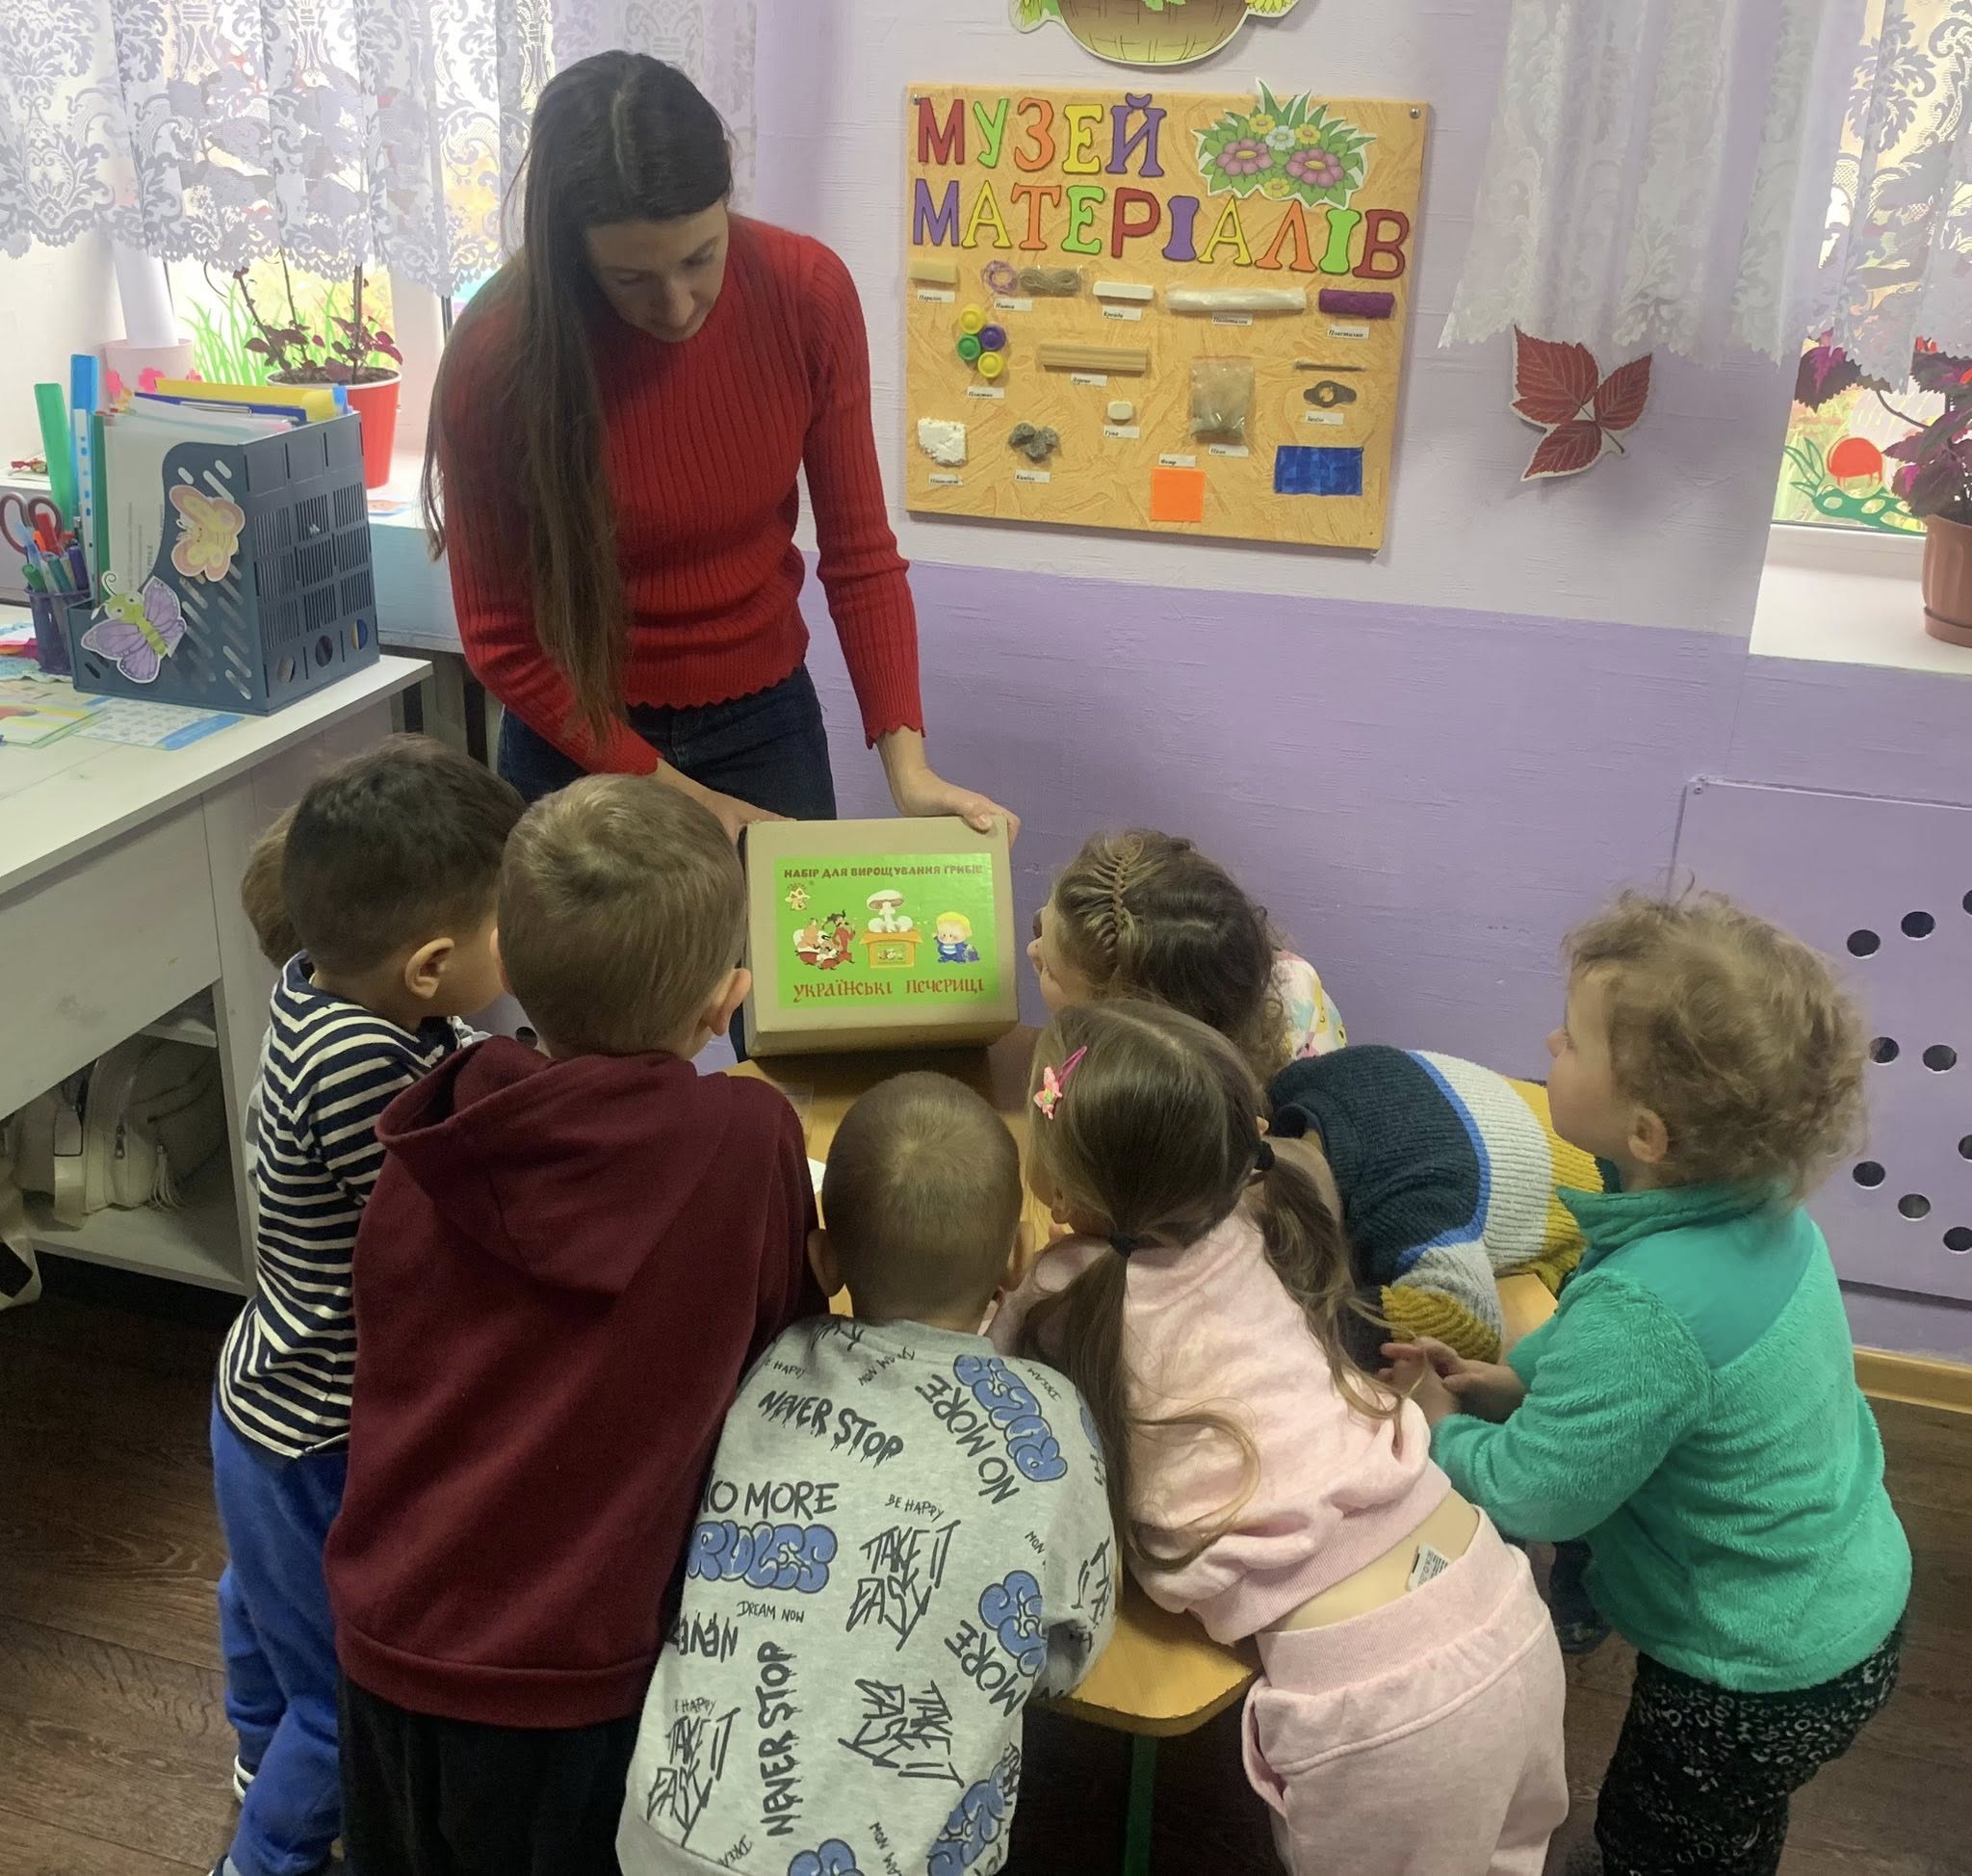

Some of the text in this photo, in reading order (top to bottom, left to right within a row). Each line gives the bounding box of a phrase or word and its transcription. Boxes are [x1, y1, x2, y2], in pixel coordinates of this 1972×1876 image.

[918, 91, 1167, 177] МУЗЕЙ
[913, 177, 1410, 279] МАТЕРІАЛІВ
[784, 868, 819, 878] НАБІР
[821, 868, 848, 878] ДЛЯ
[850, 865, 941, 878] ВИРОЩУВАННЯ
[792, 977, 984, 1003] УКРАЇНСЬКІ ПЕЧЕРИЦІ
[758, 1390, 904, 1469] NEVER STOP
[915, 1373, 996, 1457] MORE
[744, 1480, 840, 1521] MORE
[885, 1494, 945, 1523] BE HAPPY
[978, 1457, 1021, 1504] NO
[687, 1520, 838, 1594] RULES
[679, 1610, 739, 1663] NEVE
[737, 1601, 805, 1623] DREAM NOW
[944, 1620, 1027, 1717] MORE
[755, 1641, 803, 1837] NEVER STOP
